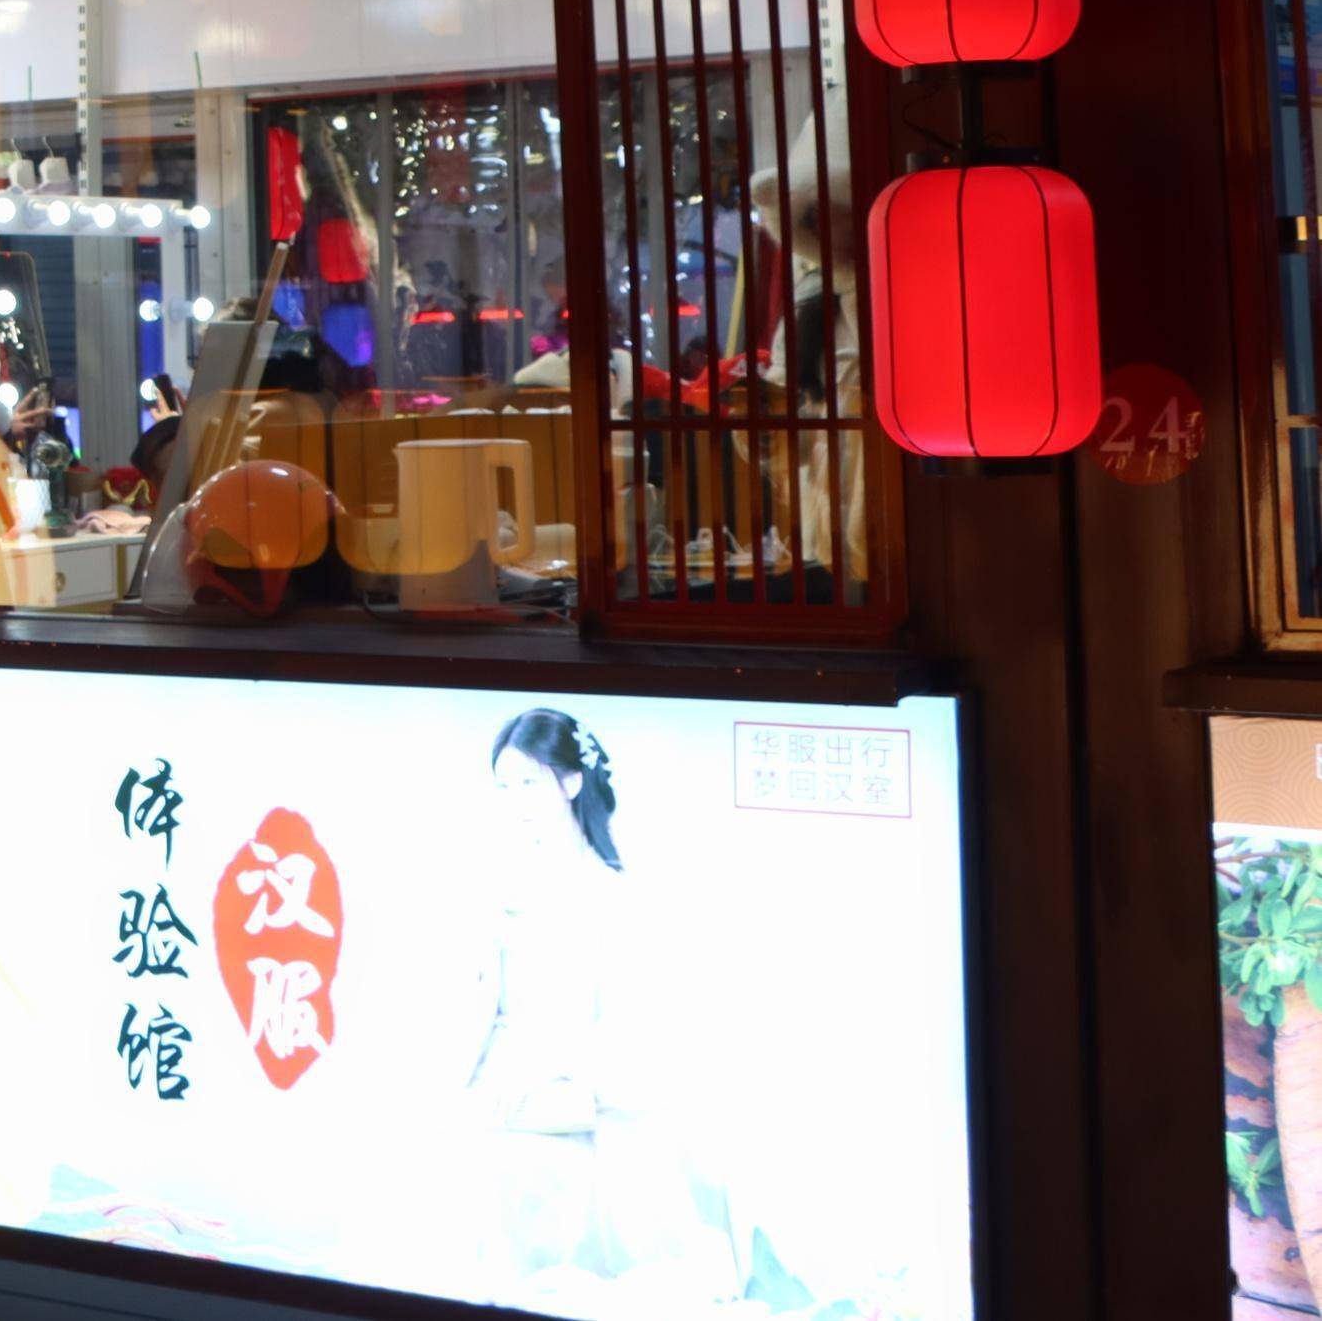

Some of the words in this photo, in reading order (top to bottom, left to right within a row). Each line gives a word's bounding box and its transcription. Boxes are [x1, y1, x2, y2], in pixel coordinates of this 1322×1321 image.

[1099, 395, 1191, 454] 24
[111, 756, 199, 1102] 体验馆
[236, 841, 336, 1059] 汉服
